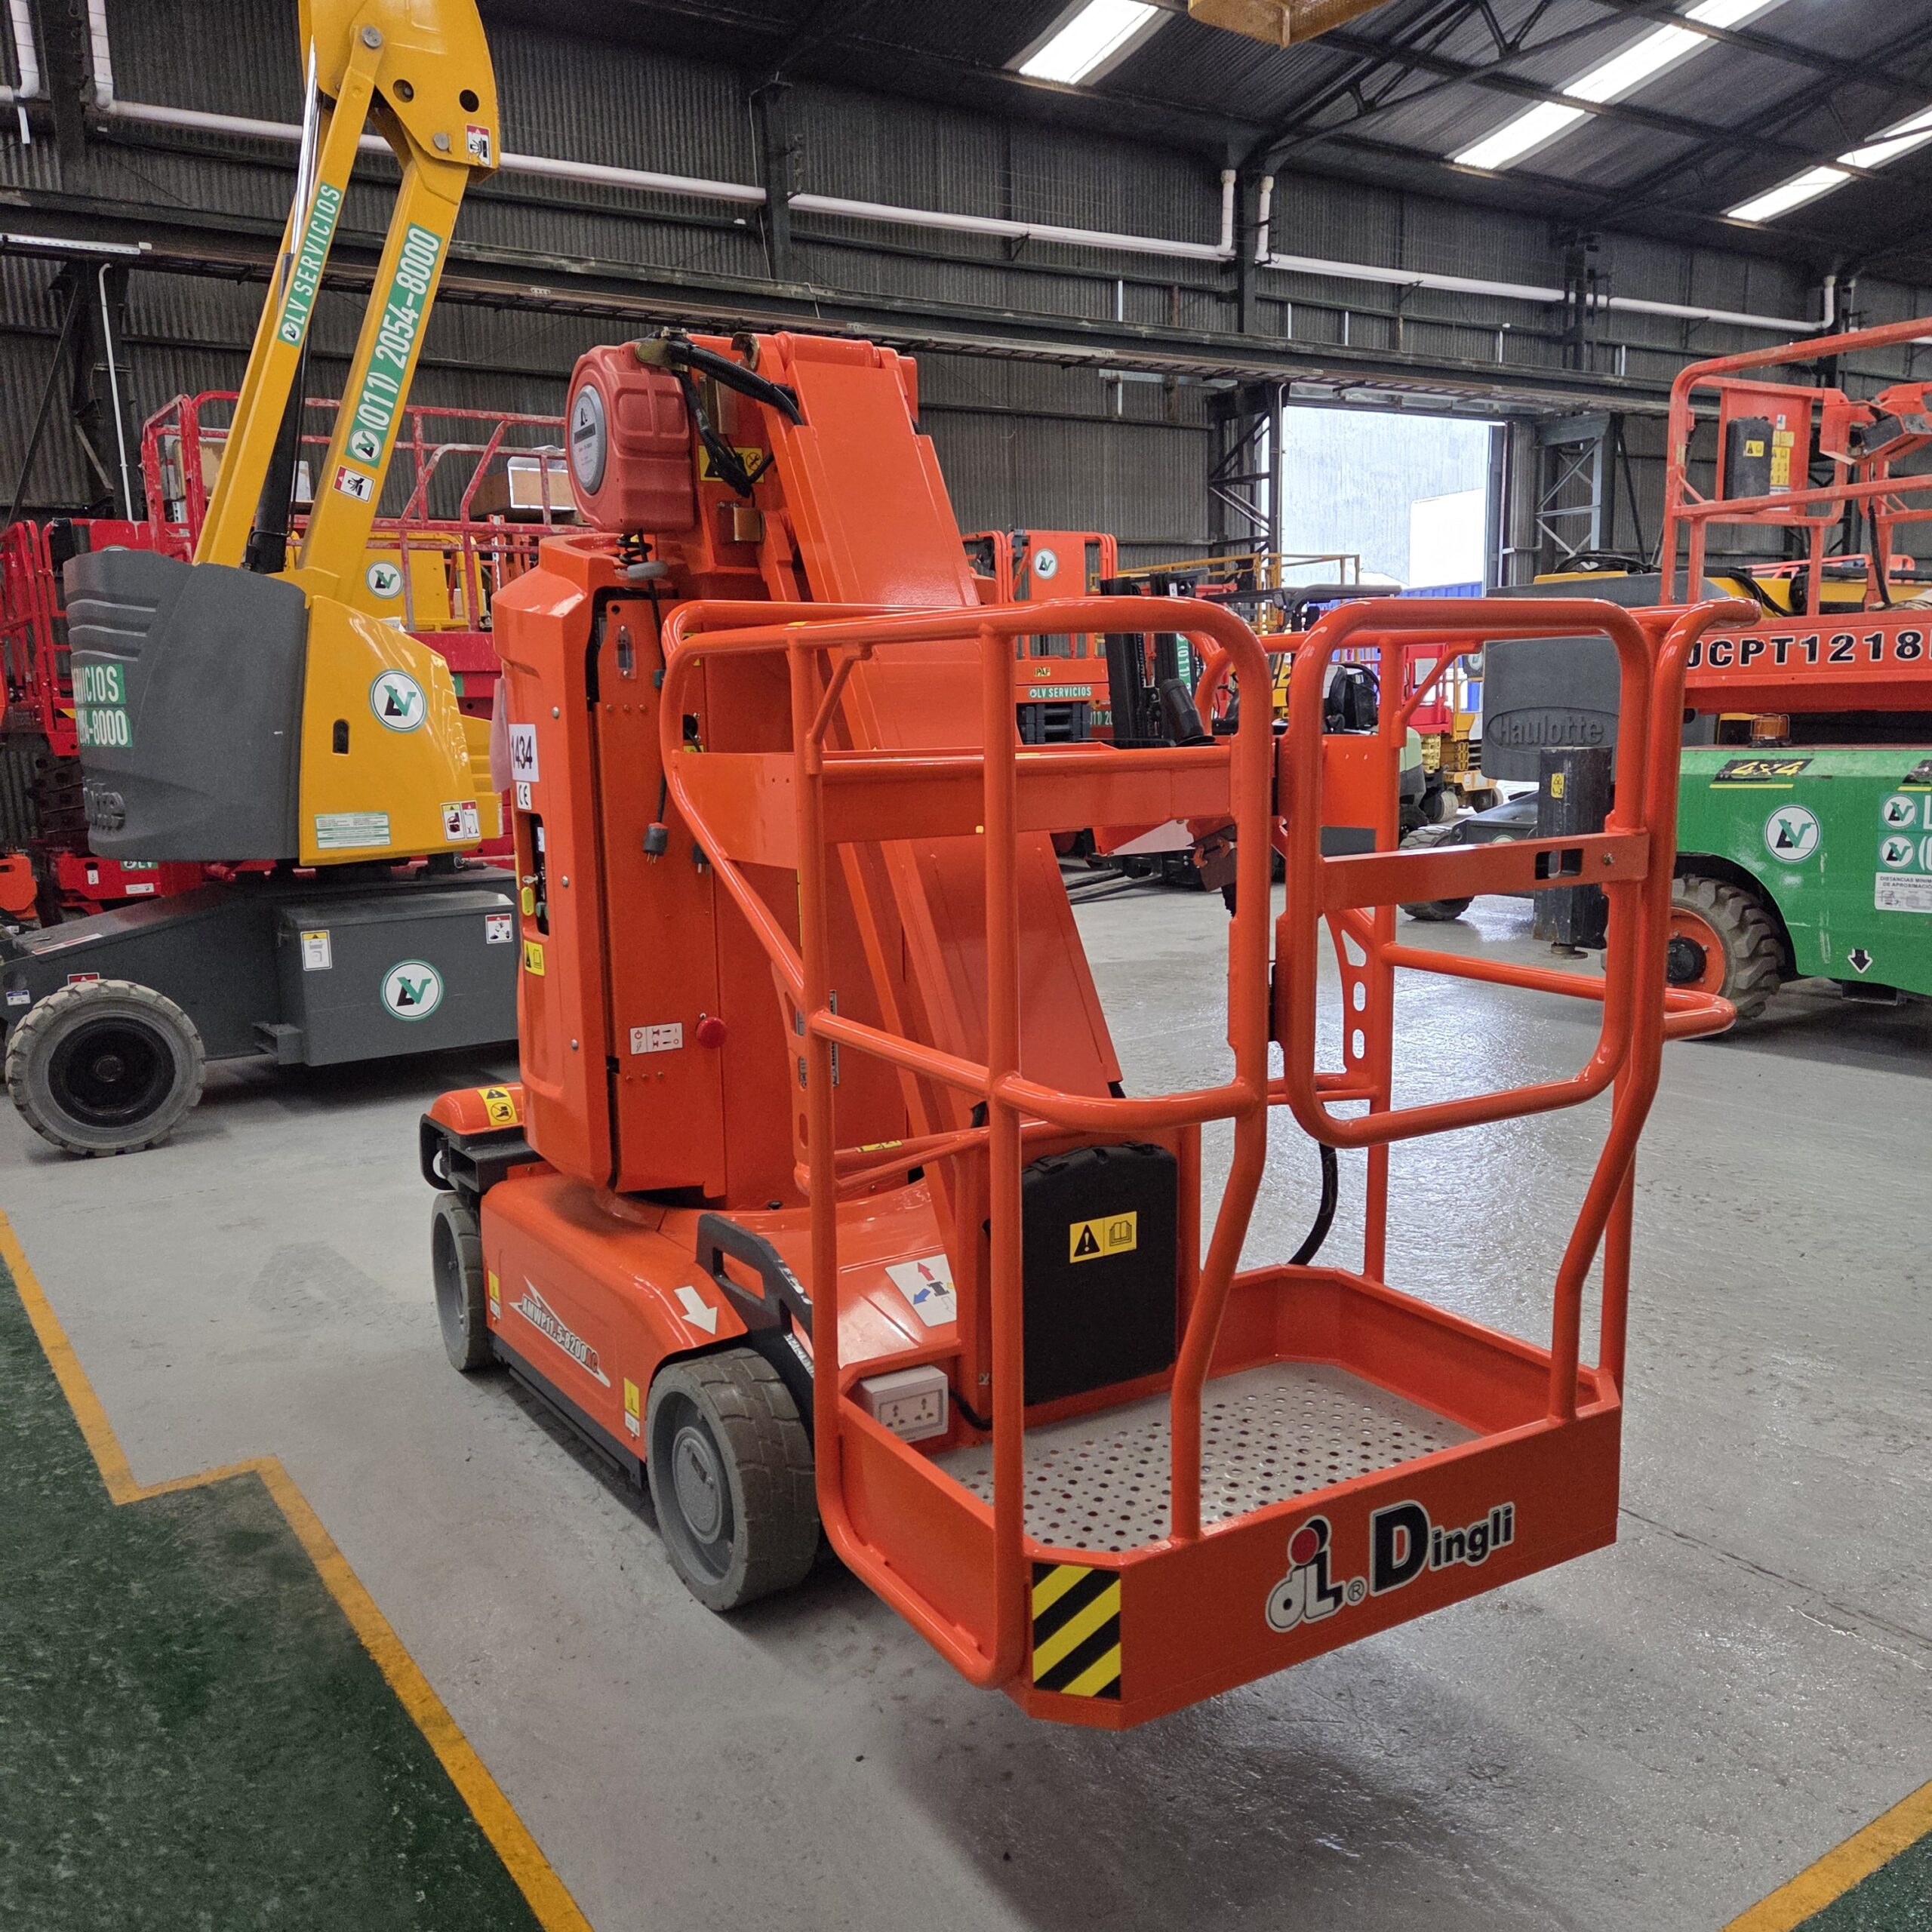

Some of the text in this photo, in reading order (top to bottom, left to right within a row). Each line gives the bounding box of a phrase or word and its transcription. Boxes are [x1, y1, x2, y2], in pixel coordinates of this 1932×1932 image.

[293, 185, 340, 296] SERVICIOS
[375, 228, 439, 369] 2054-8000
[357, 371, 399, 431] (011)
[1687, 631, 1932, 669] JCPT1218
[1048, 686, 1092, 697] SERVICIOS
[511, 735, 533, 770] 1434
[1497, 715, 1604, 746] Haulotte
[1371, 1500, 1515, 1595] Dingli
